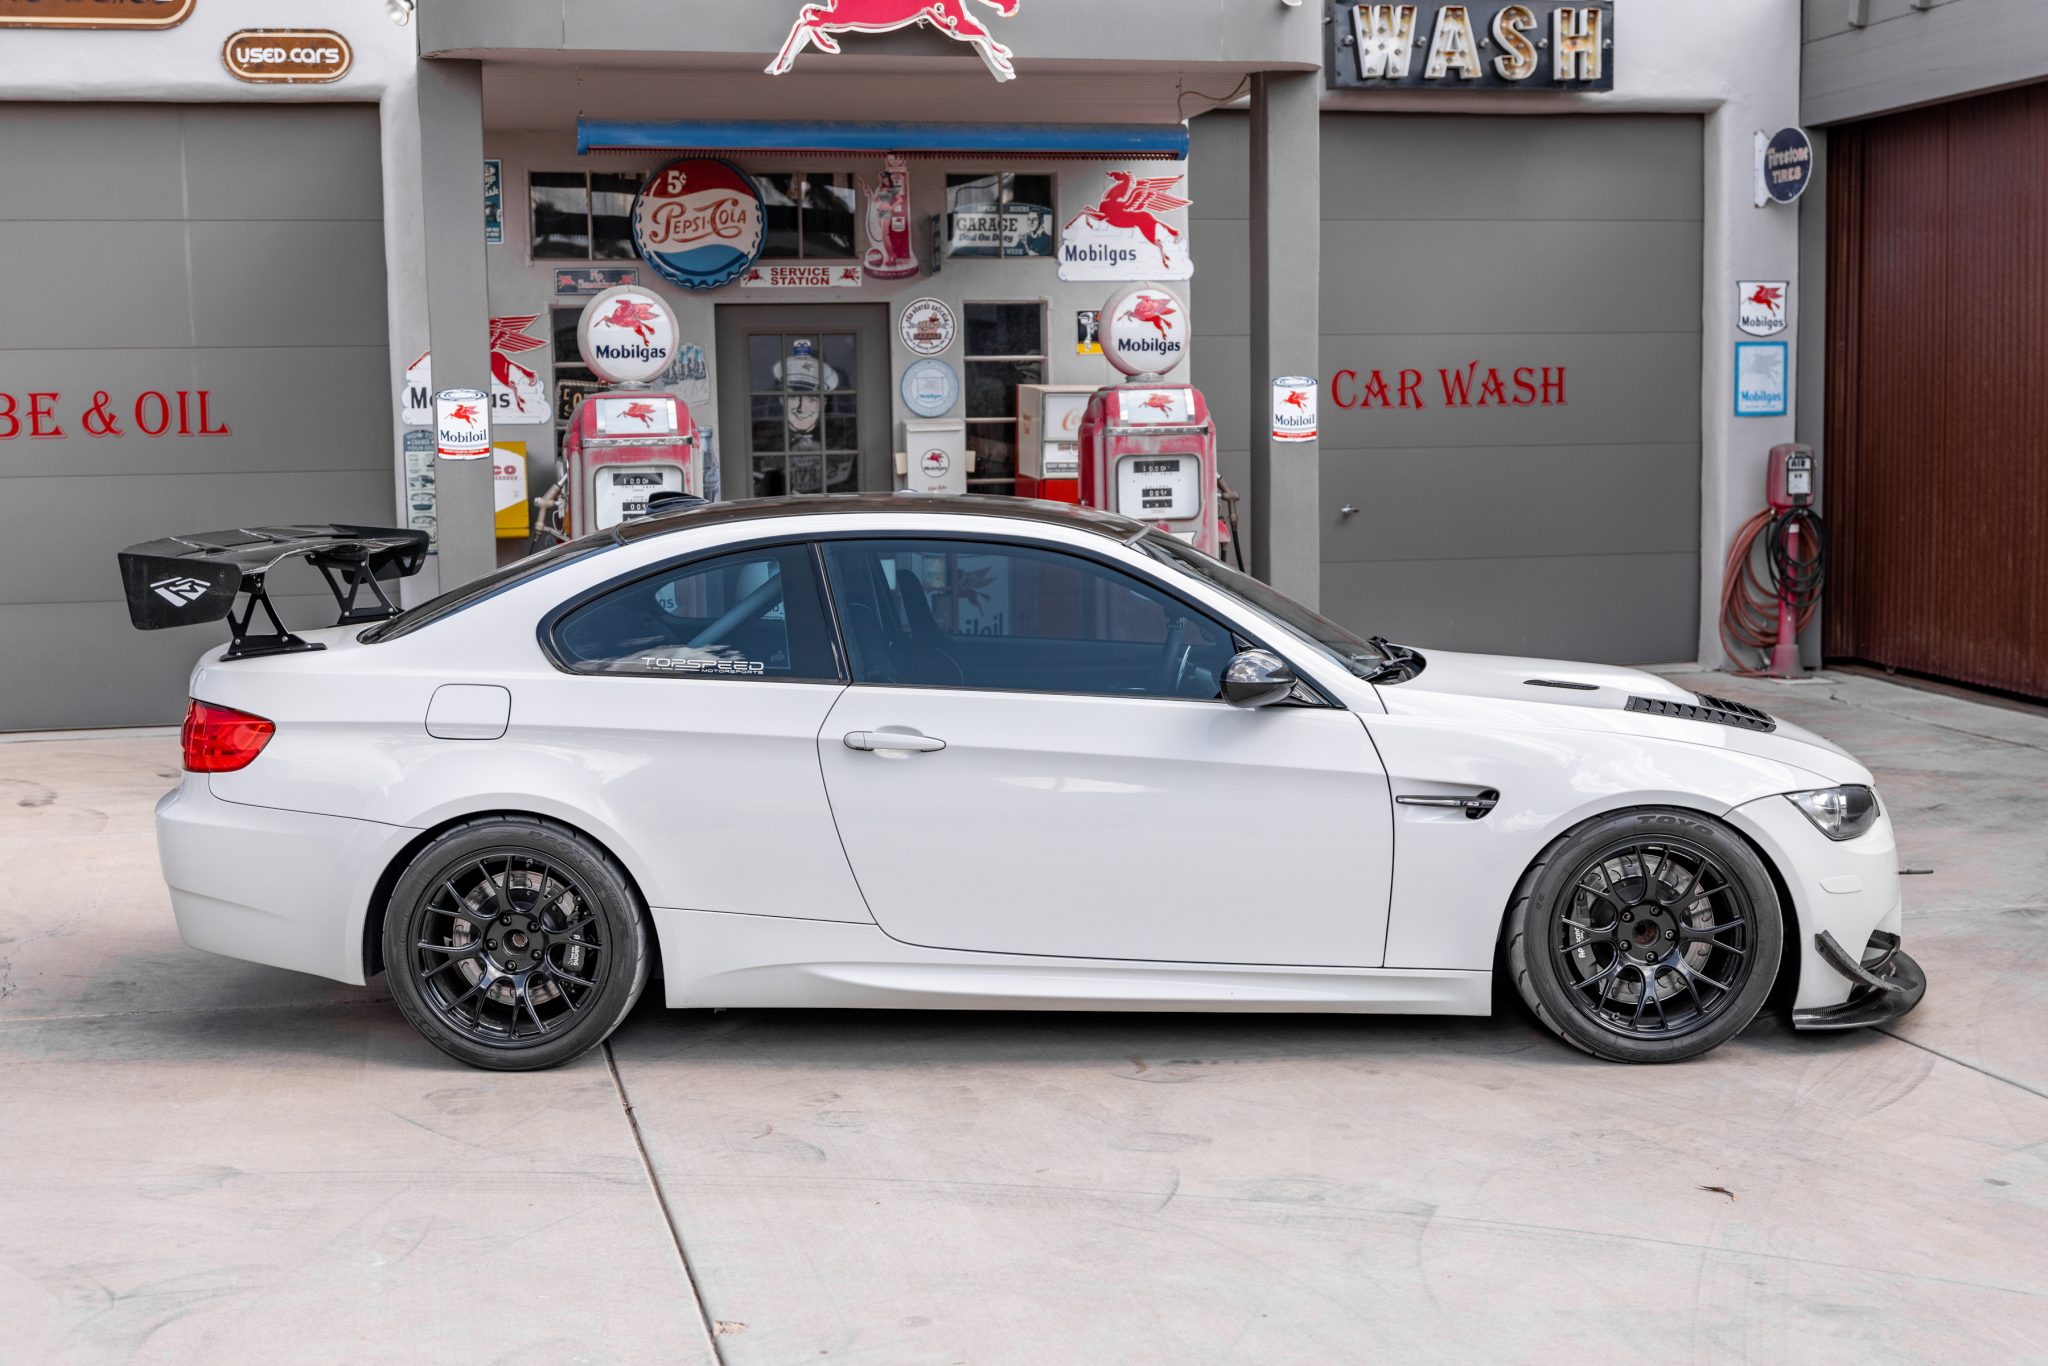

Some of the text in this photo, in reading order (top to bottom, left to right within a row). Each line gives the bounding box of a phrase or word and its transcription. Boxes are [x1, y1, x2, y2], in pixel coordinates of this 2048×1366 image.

[1353, 4, 1602, 81] WASH
[236, 47, 287, 64] USED
[956, 218, 1018, 232] GARAGE
[992, 234, 1014, 243] Dty
[1066, 244, 1136, 266] Mobilgas
[770, 268, 830, 276] SERVICE
[770, 276, 830, 286] STATION
[1742, 316, 1784, 330] Mobilgas
[596, 344, 666, 362] Mobilgas
[1118, 338, 1182, 355] Mobilgas
[1331, 359, 1568, 410] CAR WASH
[1742, 391, 1781, 404] Mobilgas
[134, 390, 232, 436] OIL
[1274, 414, 1315, 426] Mobiloil
[440, 429, 487, 442] Mobiloil
[641, 656, 764, 671] TOPSPEED
[1637, 815, 1714, 836] TOYO
